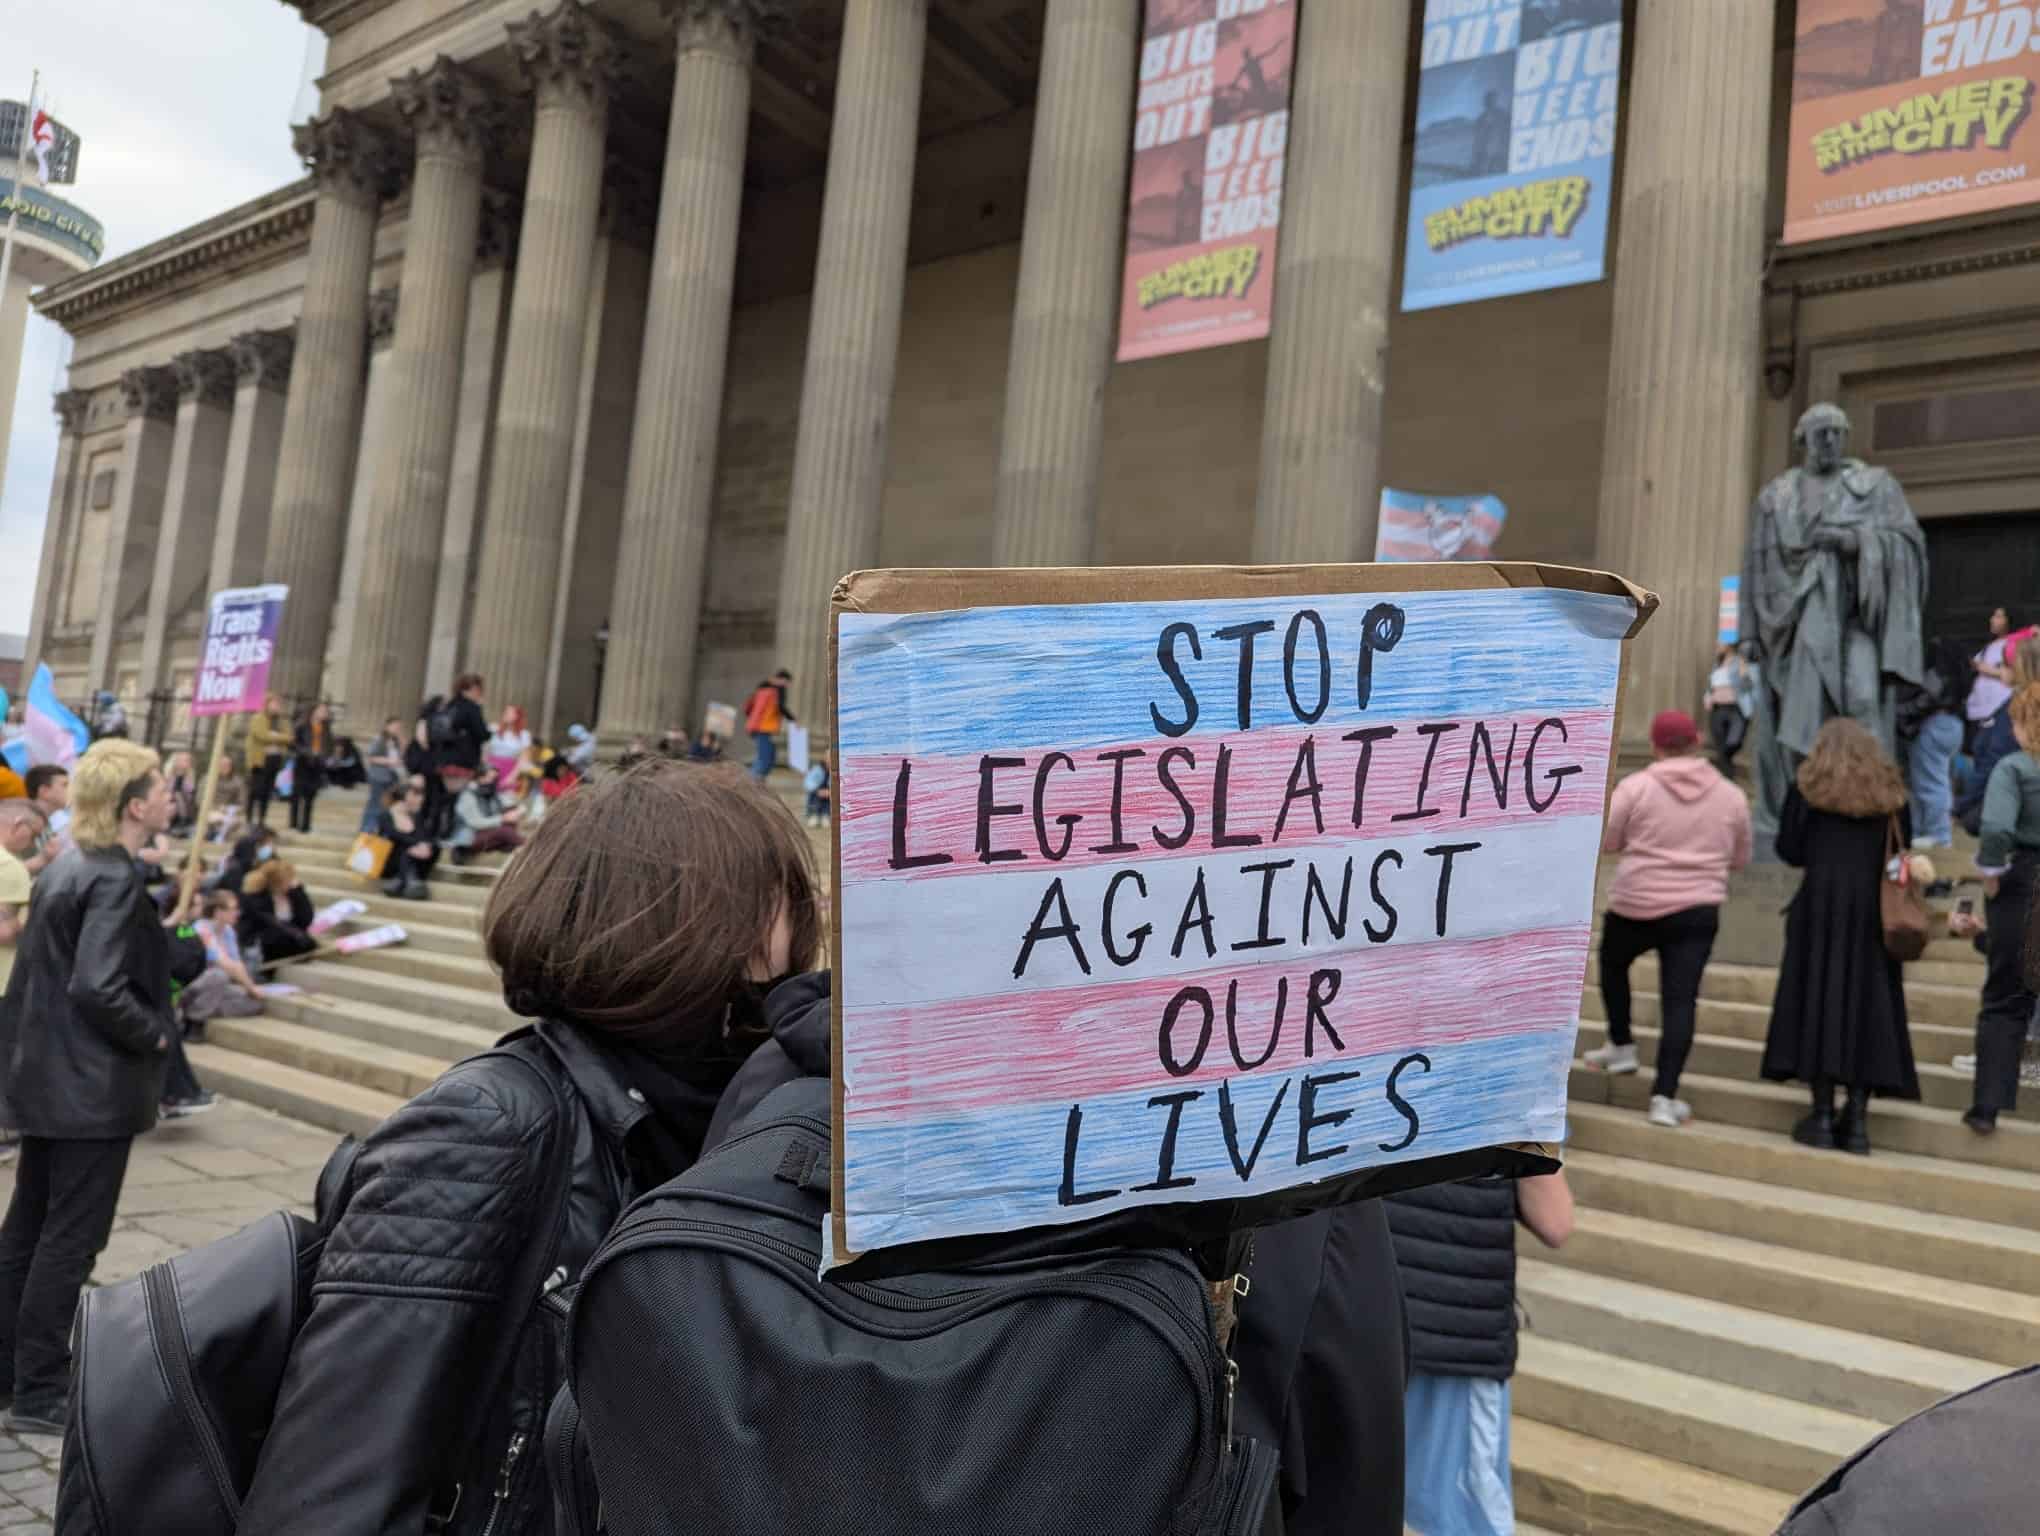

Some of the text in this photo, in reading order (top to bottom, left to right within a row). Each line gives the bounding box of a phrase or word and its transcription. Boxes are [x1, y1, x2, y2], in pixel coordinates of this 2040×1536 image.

[1140, 20, 1217, 81] BIG
[1421, 9, 1520, 68] OUT
[1514, 20, 1621, 89] BIG
[1134, 94, 1213, 150] OUT
[1205, 110, 1288, 171] BIG
[1811, 76, 2029, 146] SUMMER
[1892, 106, 2021, 153] CITY
[1507, 112, 1615, 174] ENDS
[1200, 186, 1282, 244] ENDS
[1425, 175, 1587, 227] SUMMER
[1486, 200, 1583, 238] CITY
[1184, 268, 1255, 299] CITY
[208, 602, 264, 635] Trans
[204, 636, 272, 674] Rights
[1149, 602, 1406, 738] STOP
[197, 669, 245, 702] Now
[889, 718, 1584, 871] LEGISLATING
[1012, 841, 1483, 979] AGAINST
[1157, 967, 1346, 1079] OUR
[1057, 1053, 1432, 1207] LIVES
